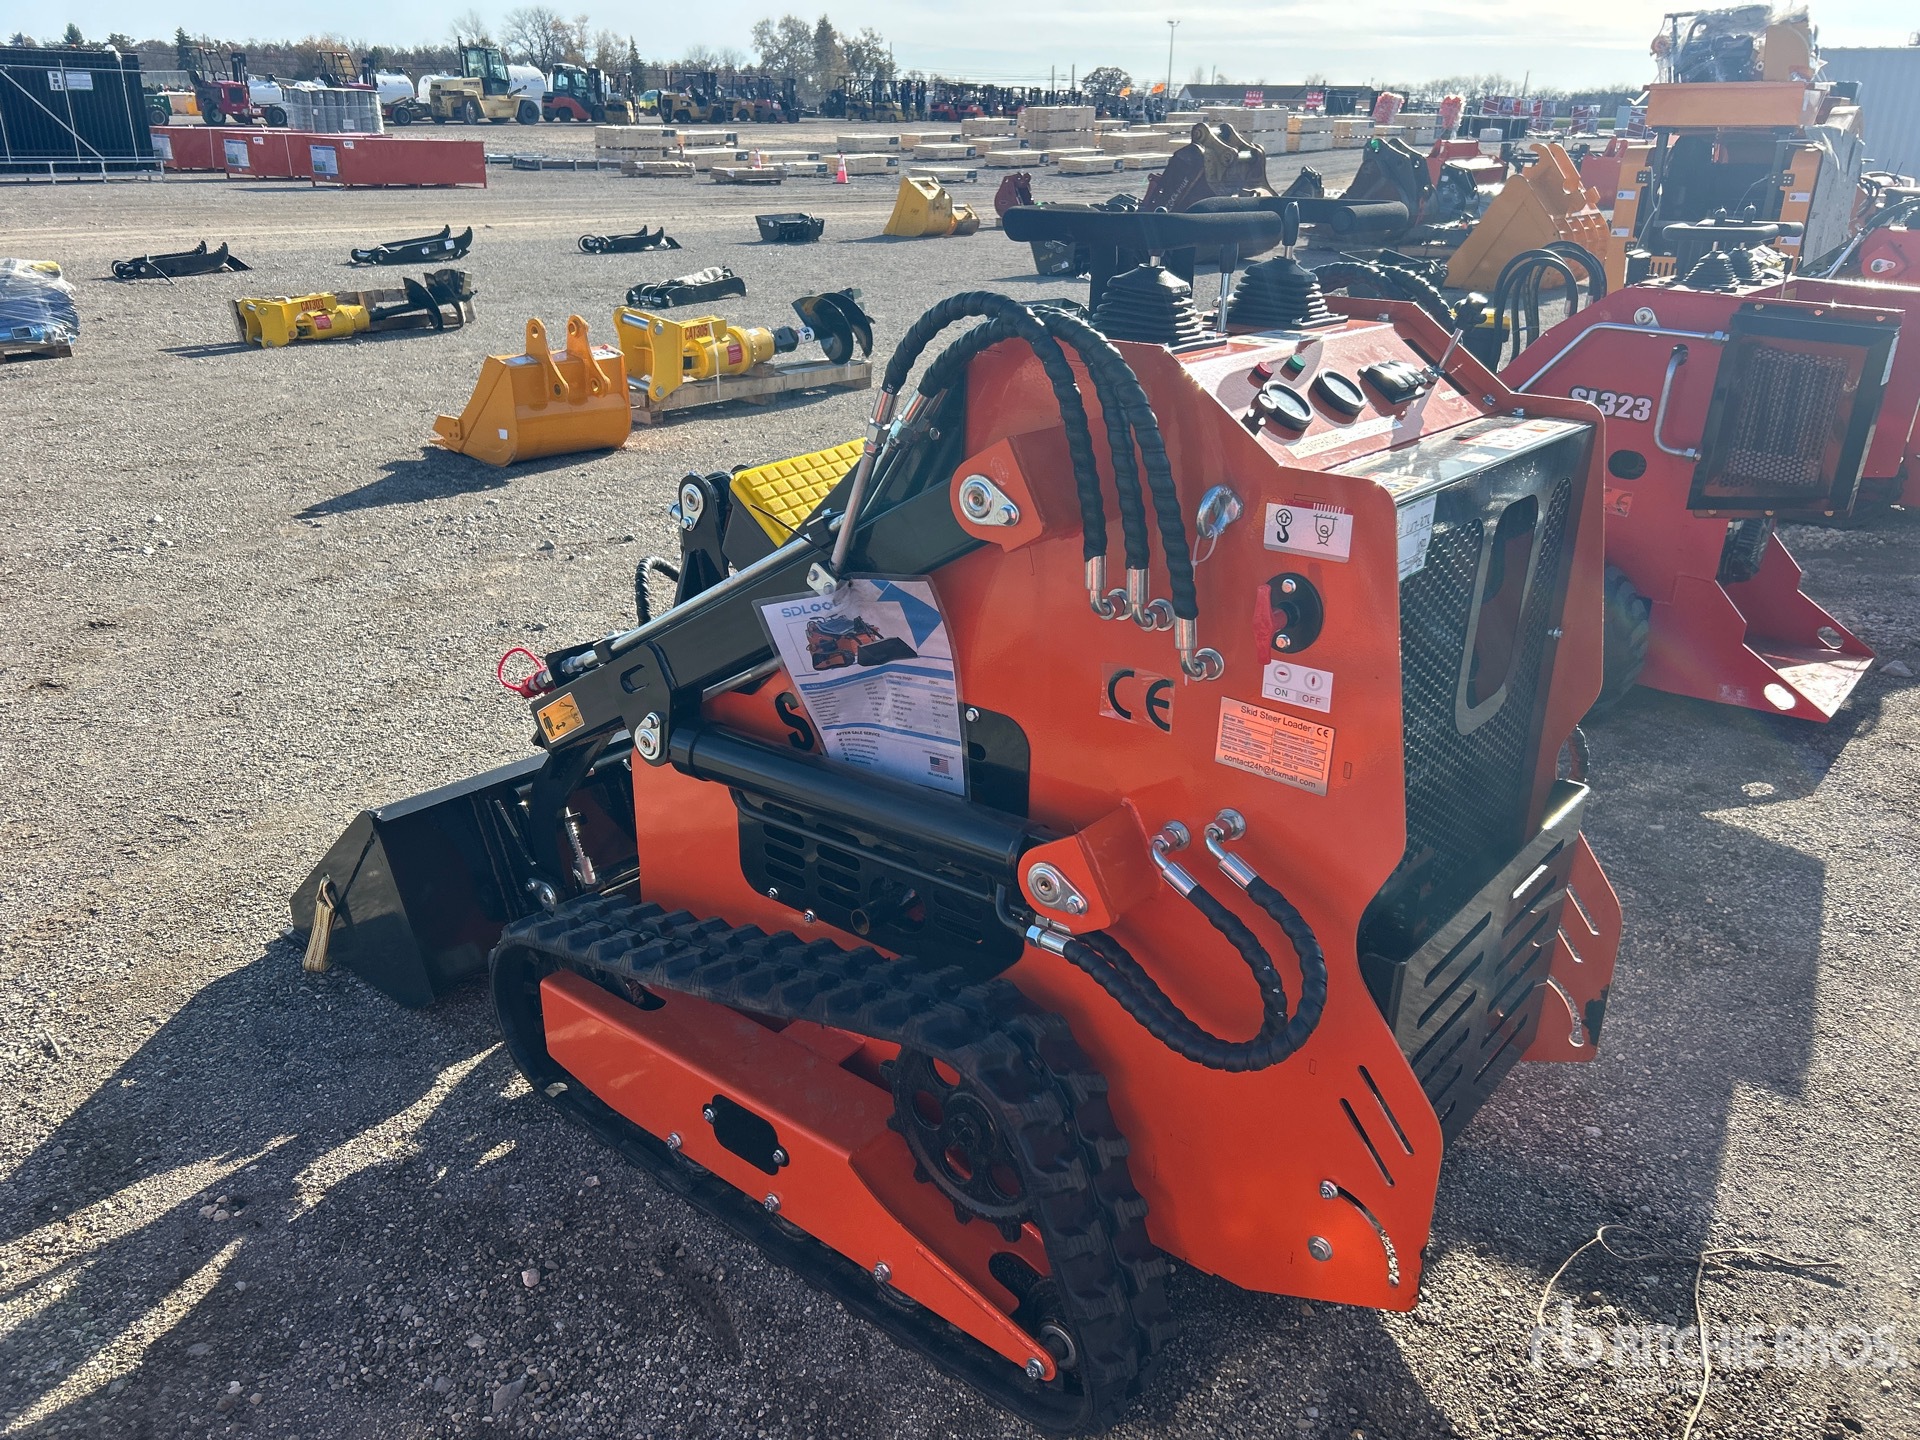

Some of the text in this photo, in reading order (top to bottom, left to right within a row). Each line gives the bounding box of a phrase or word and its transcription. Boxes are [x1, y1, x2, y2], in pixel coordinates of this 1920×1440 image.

[300, 298, 325, 312] CAT303
[684, 324, 708, 341] CAT305
[1107, 668, 1174, 732] CE
[1274, 686, 1322, 705] ON OFF
[1240, 704, 1312, 732] Skid Steer Loader
[1316, 727, 1329, 738] CE
[1223, 753, 1316, 788] contact24h@foxmail.com
